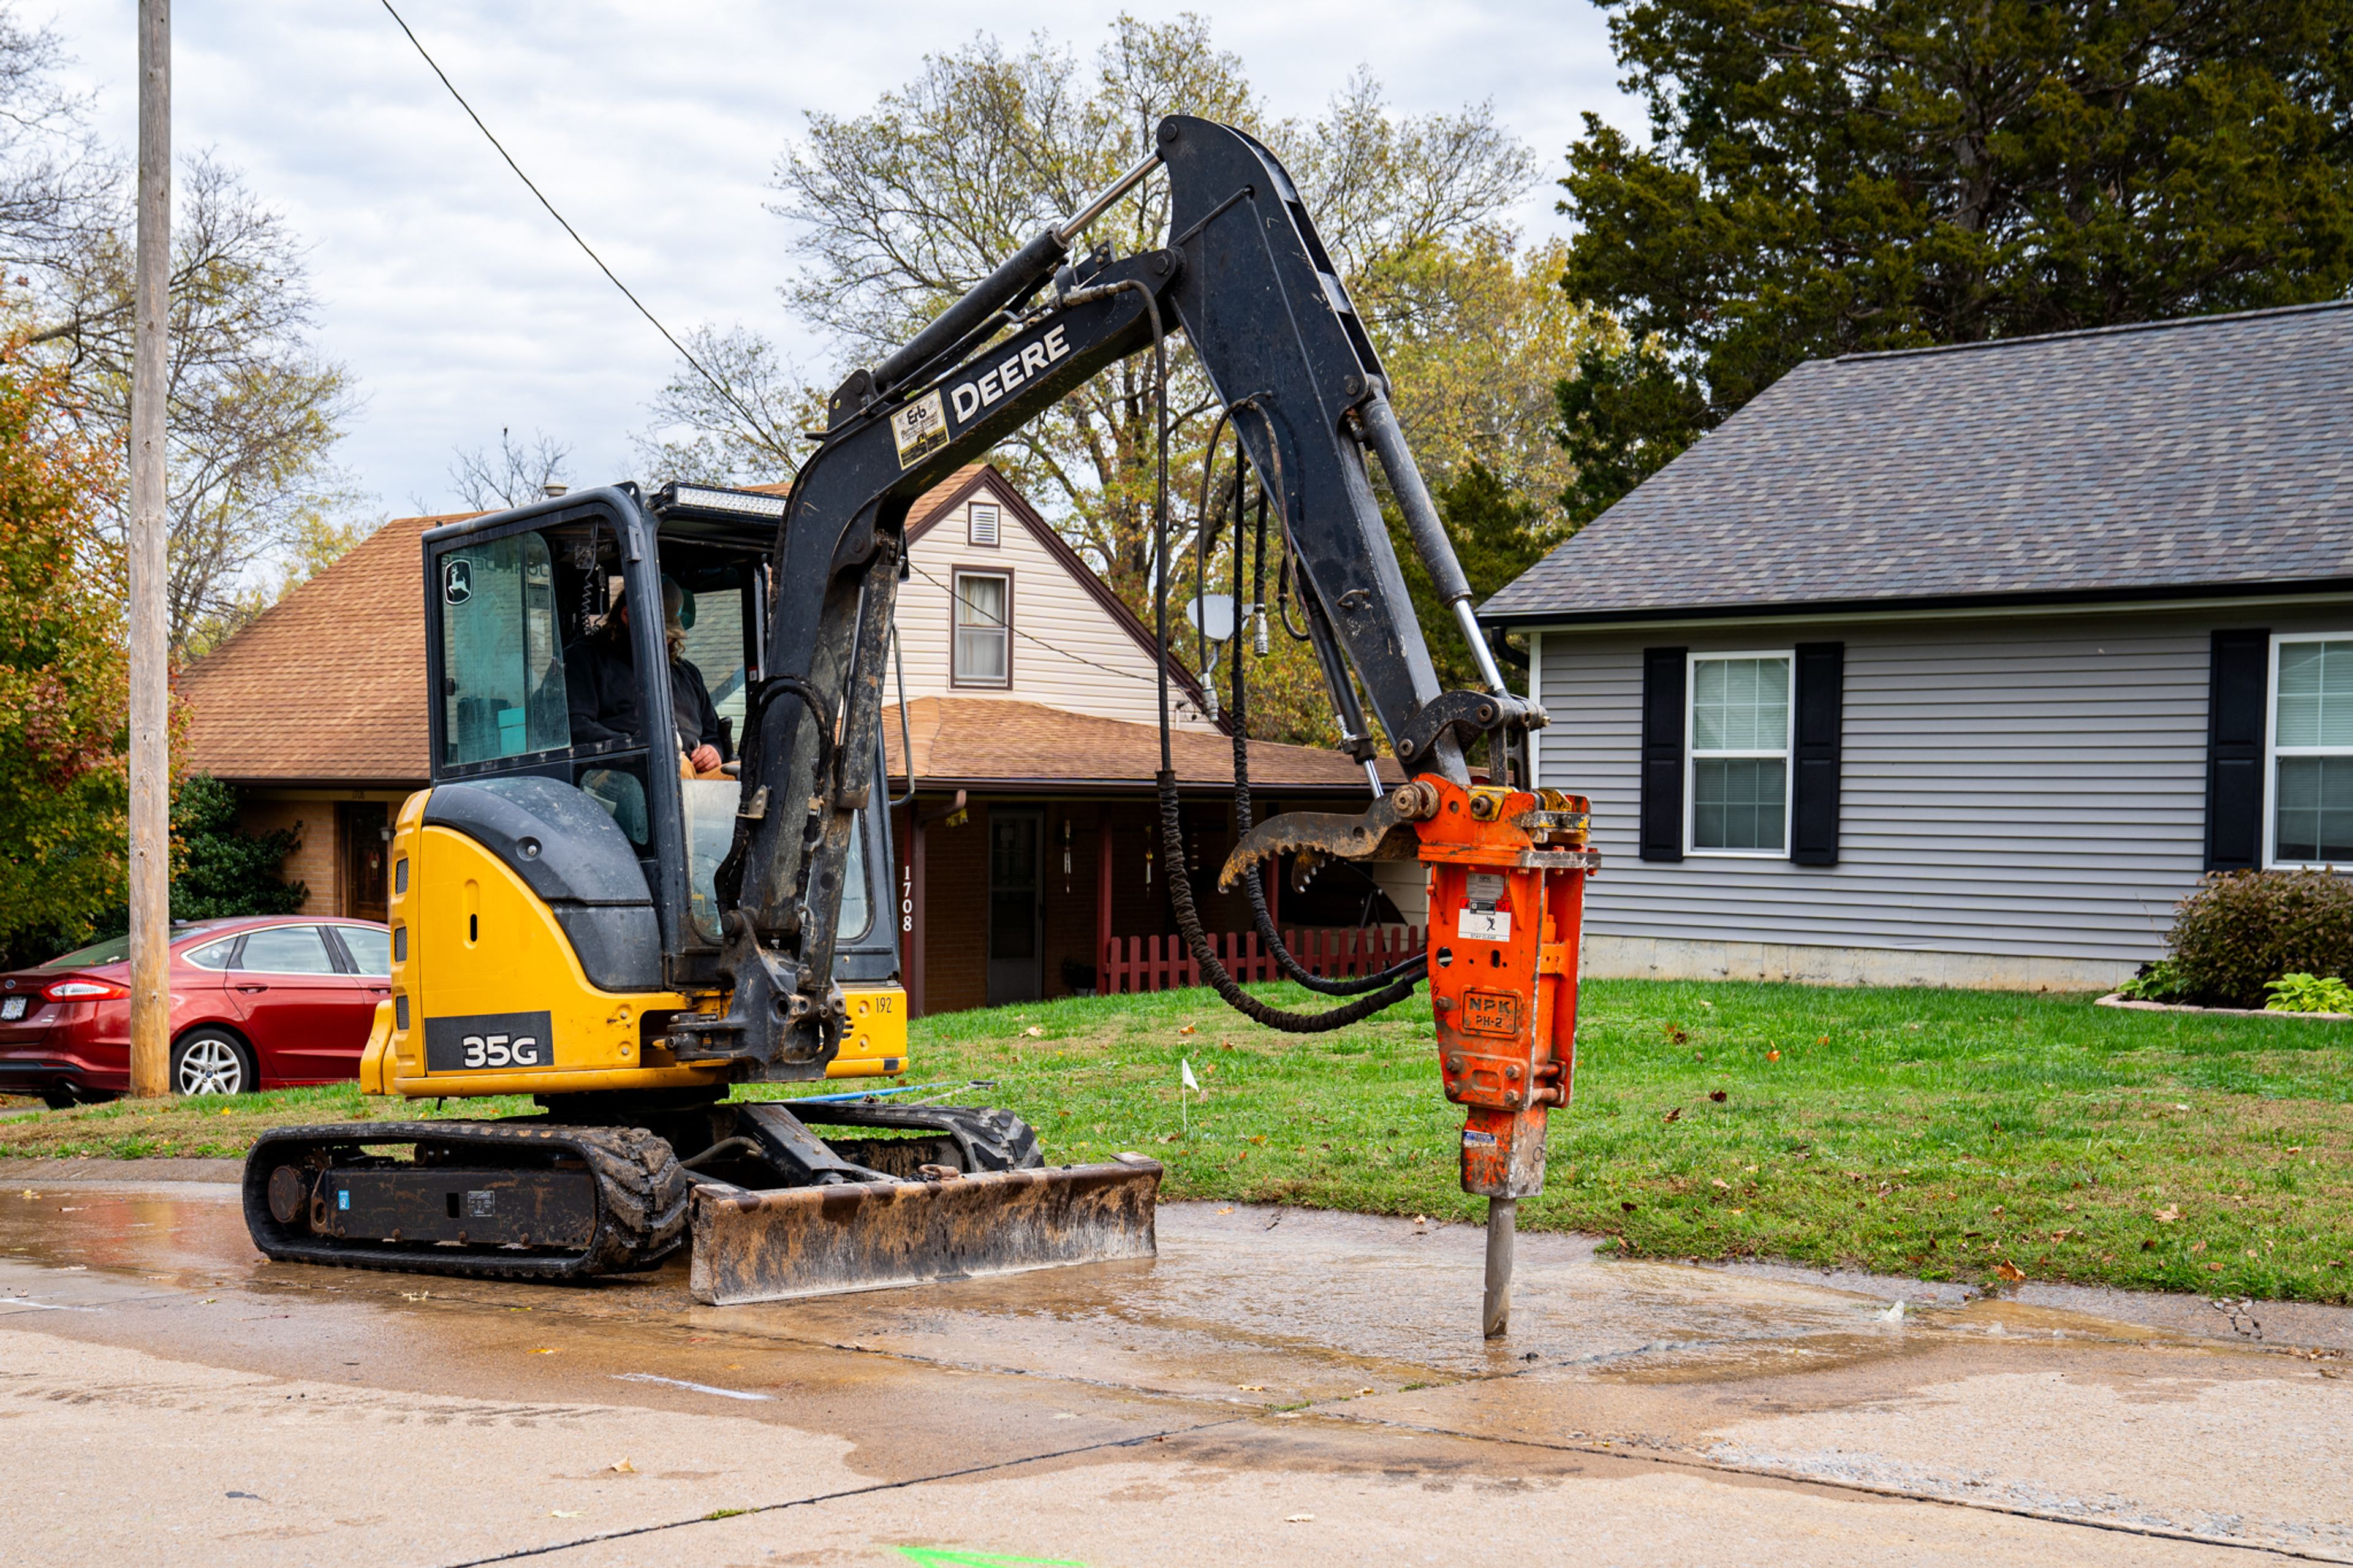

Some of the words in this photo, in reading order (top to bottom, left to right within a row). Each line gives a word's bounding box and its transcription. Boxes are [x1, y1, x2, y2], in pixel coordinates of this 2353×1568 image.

[951, 324, 1070, 423] DEERE
[907, 405, 926, 425] Erb
[903, 865, 912, 931] 1708
[875, 997, 892, 1013] 192
[1469, 998, 1511, 1014] NPK
[1476, 1015, 1502, 1028] PH-2
[463, 1034, 537, 1067] 35G
